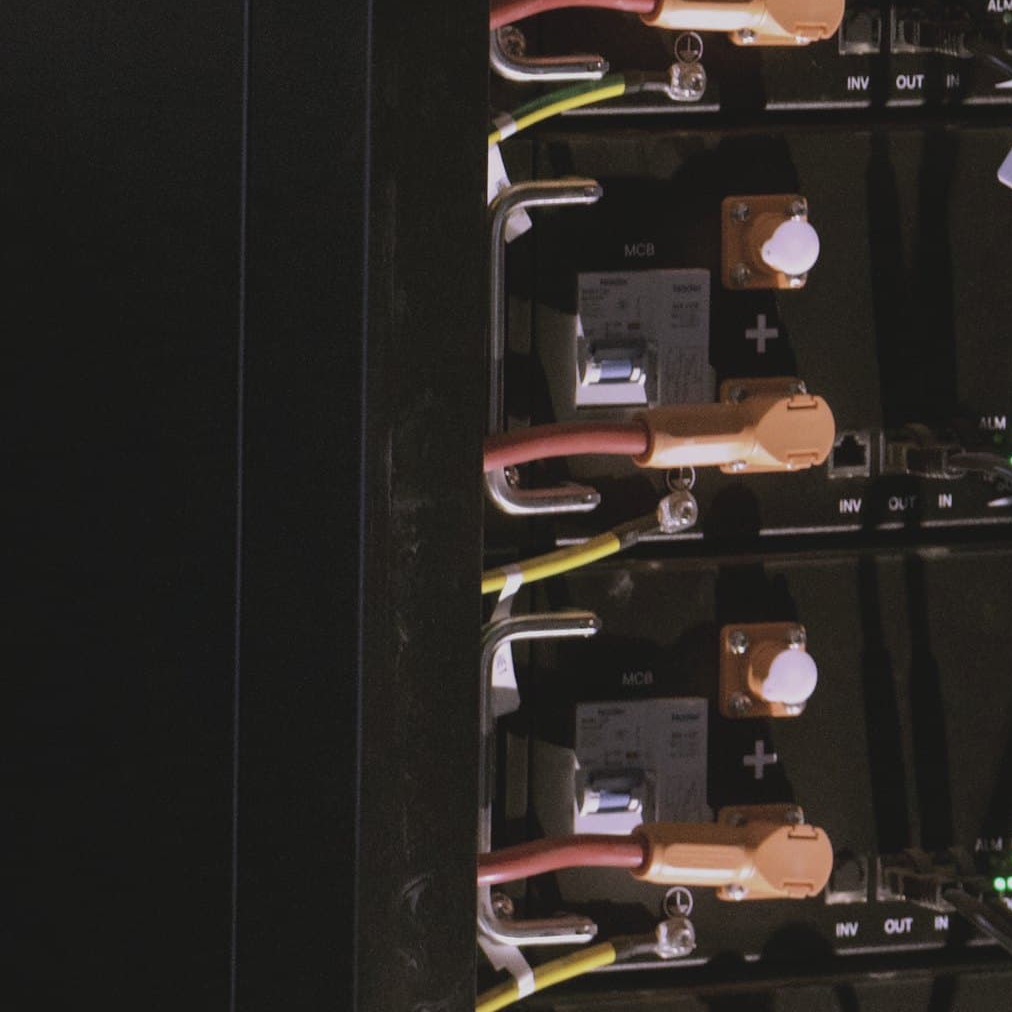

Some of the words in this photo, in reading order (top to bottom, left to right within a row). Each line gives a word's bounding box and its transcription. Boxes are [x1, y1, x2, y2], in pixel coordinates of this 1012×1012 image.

[847, 76, 870, 91] INV
[895, 74, 925, 90] OUT
[946, 74, 960, 89] IN
[624, 241, 655, 257] MCB
[979, 415, 1006, 431] ALM
[839, 498, 862, 514] INV
[888, 495, 917, 511] OUT
[938, 492, 953, 508] IN
[622, 669, 654, 685] MCB
[975, 837, 1003, 852] ALM
[835, 921, 859, 938] INV
[884, 917, 914, 934] OUT
[934, 914, 949, 931] IN
